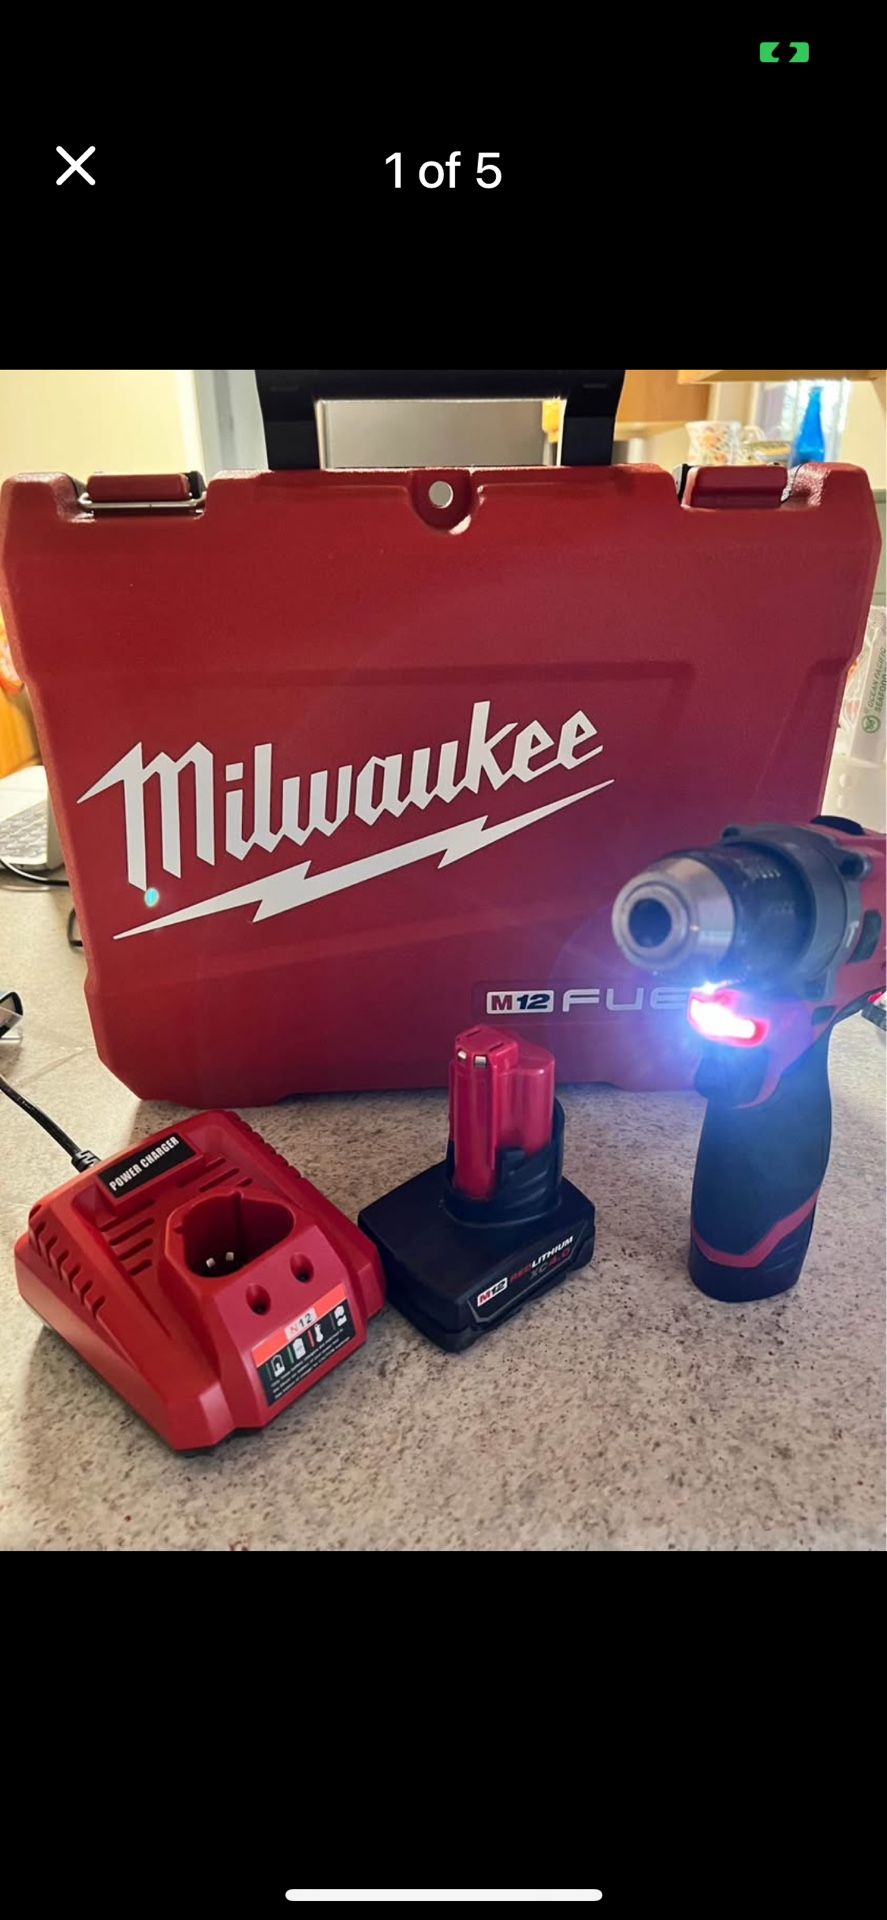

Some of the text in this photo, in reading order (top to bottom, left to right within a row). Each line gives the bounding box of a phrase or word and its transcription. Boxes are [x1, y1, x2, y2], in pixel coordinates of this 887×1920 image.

[77, 700, 603, 891] Milwaukee
[490, 987, 691, 1012] M12 FUE
[108, 1136, 179, 1191] POWER CHARGER
[479, 1279, 507, 1304] M12
